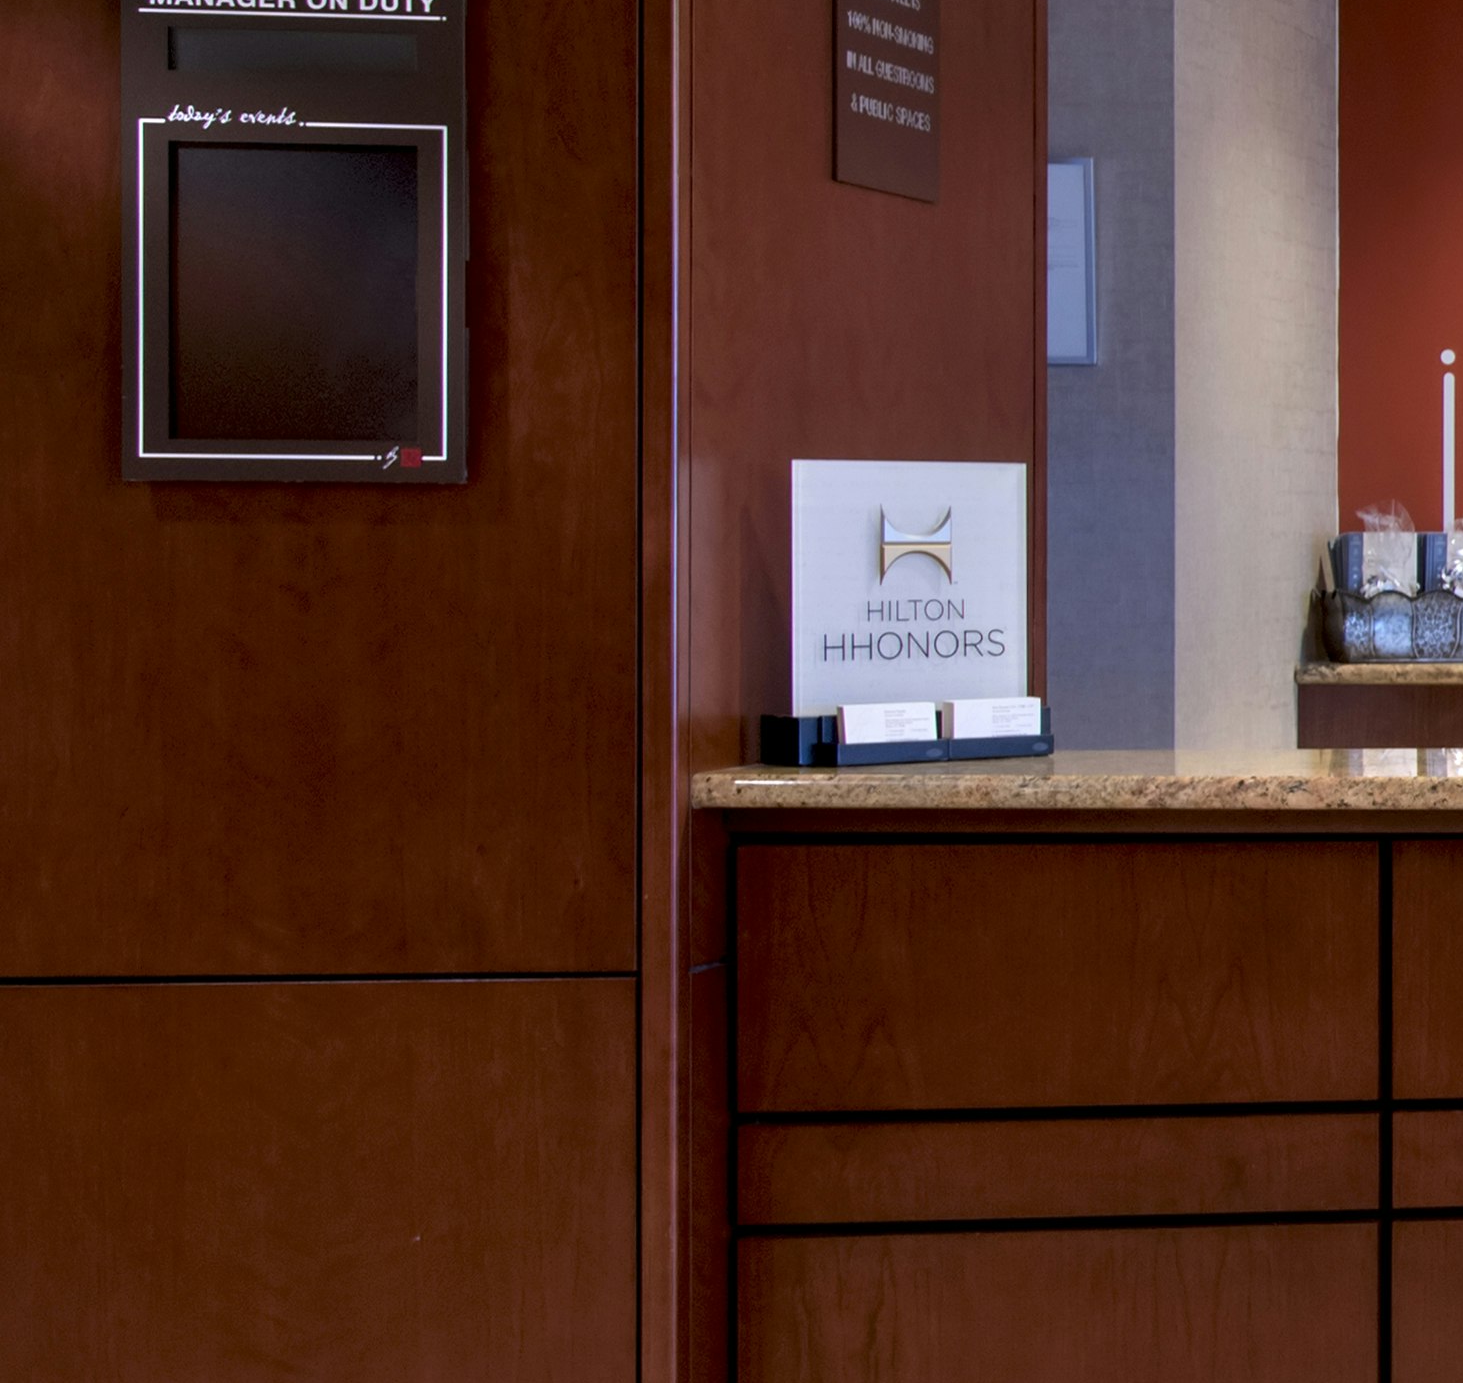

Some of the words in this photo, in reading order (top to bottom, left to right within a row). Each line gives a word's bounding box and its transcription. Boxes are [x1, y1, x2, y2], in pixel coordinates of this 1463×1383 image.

[858, 54, 874, 75] ALL
[168, 104, 232, 130] today's
[859, 95, 894, 122] PUBLIC
[895, 106, 931, 132] SPACES
[867, 599, 965, 622] HILTON
[824, 628, 1006, 662] HHONORS
